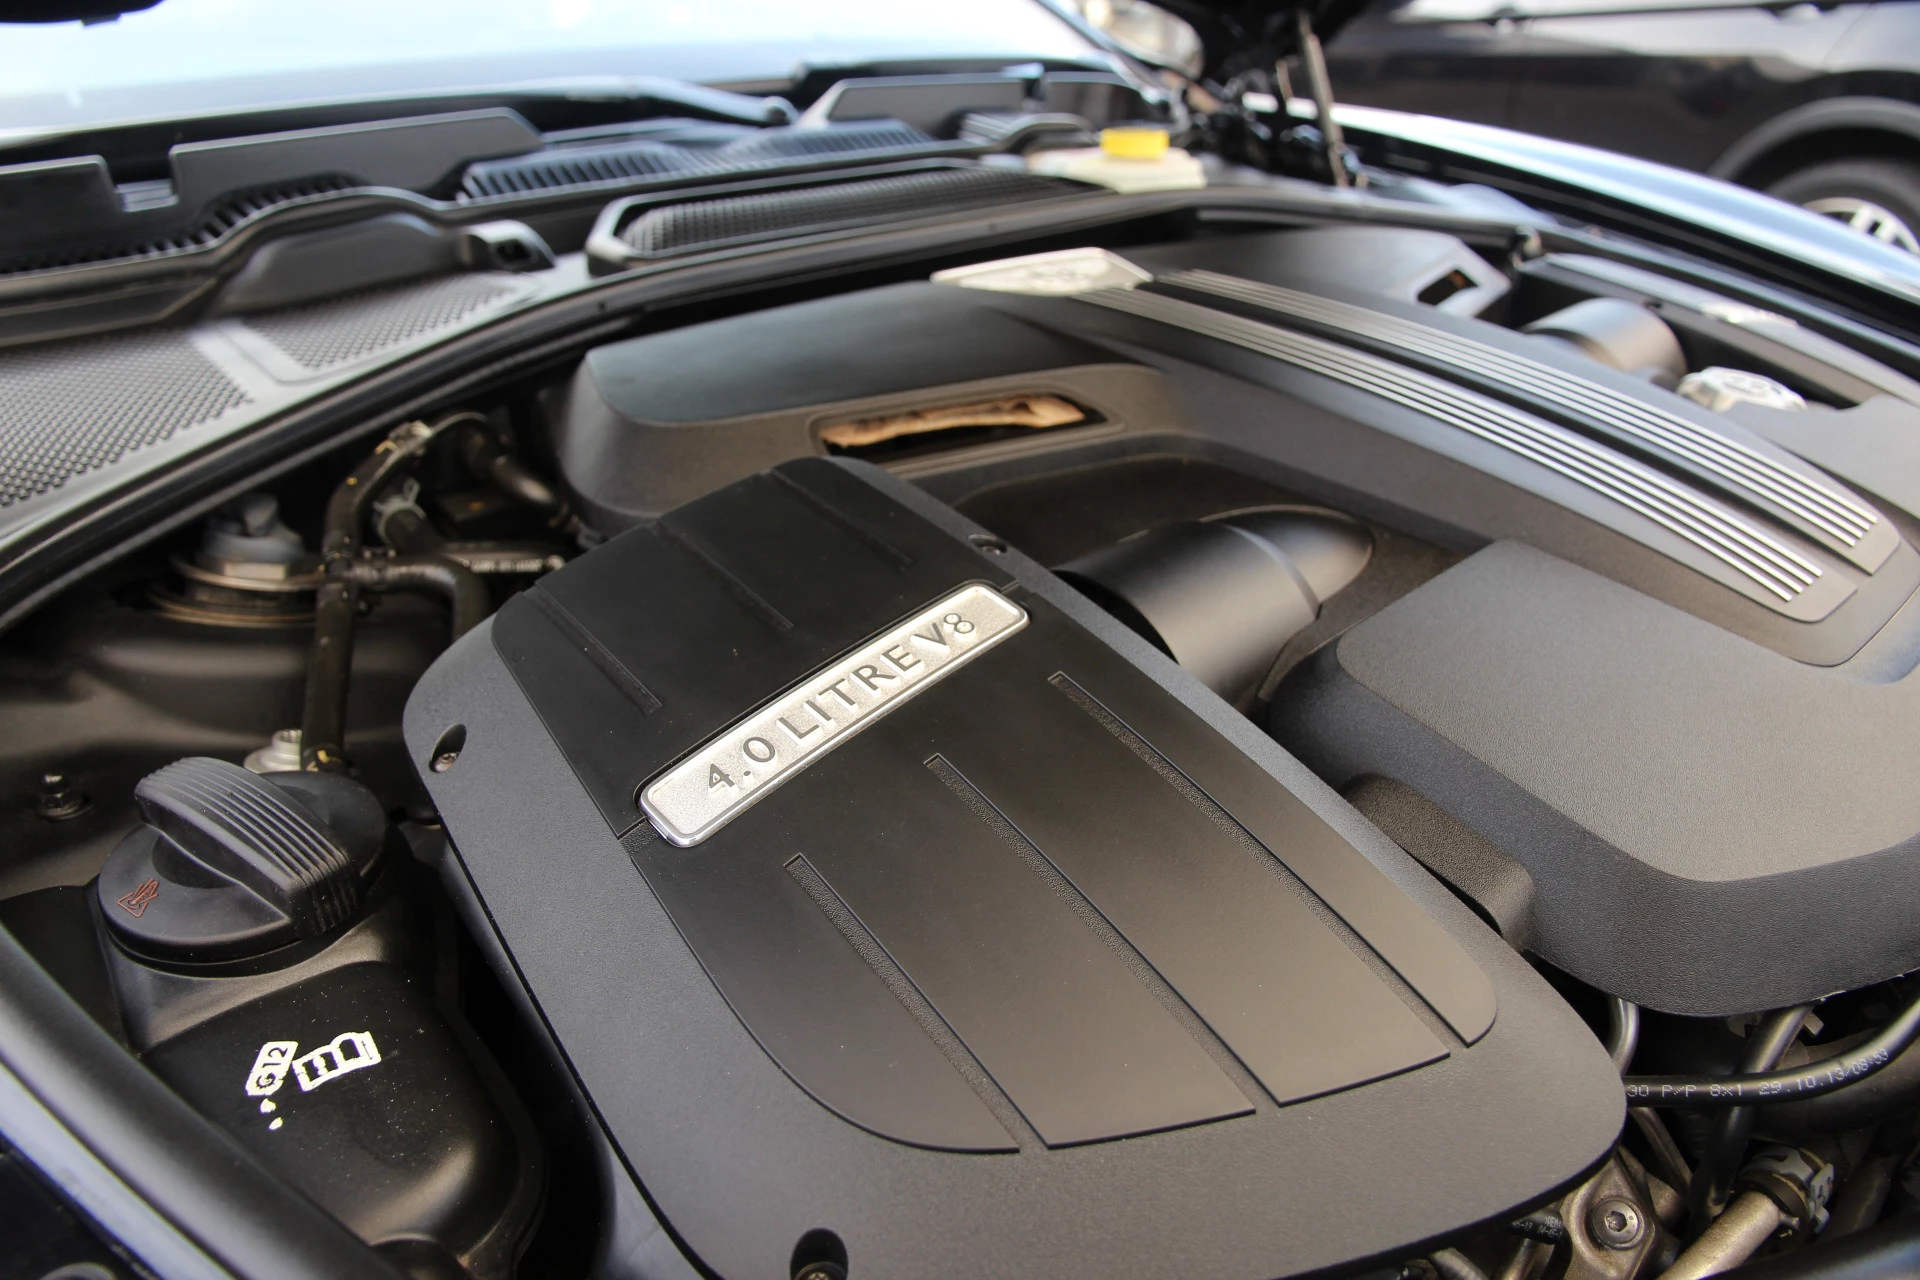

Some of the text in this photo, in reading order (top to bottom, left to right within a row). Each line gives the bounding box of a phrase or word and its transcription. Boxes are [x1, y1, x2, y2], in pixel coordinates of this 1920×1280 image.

[707, 612, 976, 789] 4.0 LITRE V8
[255, 1046, 290, 1090] G12
[1661, 1084, 1697, 1098] P/P
